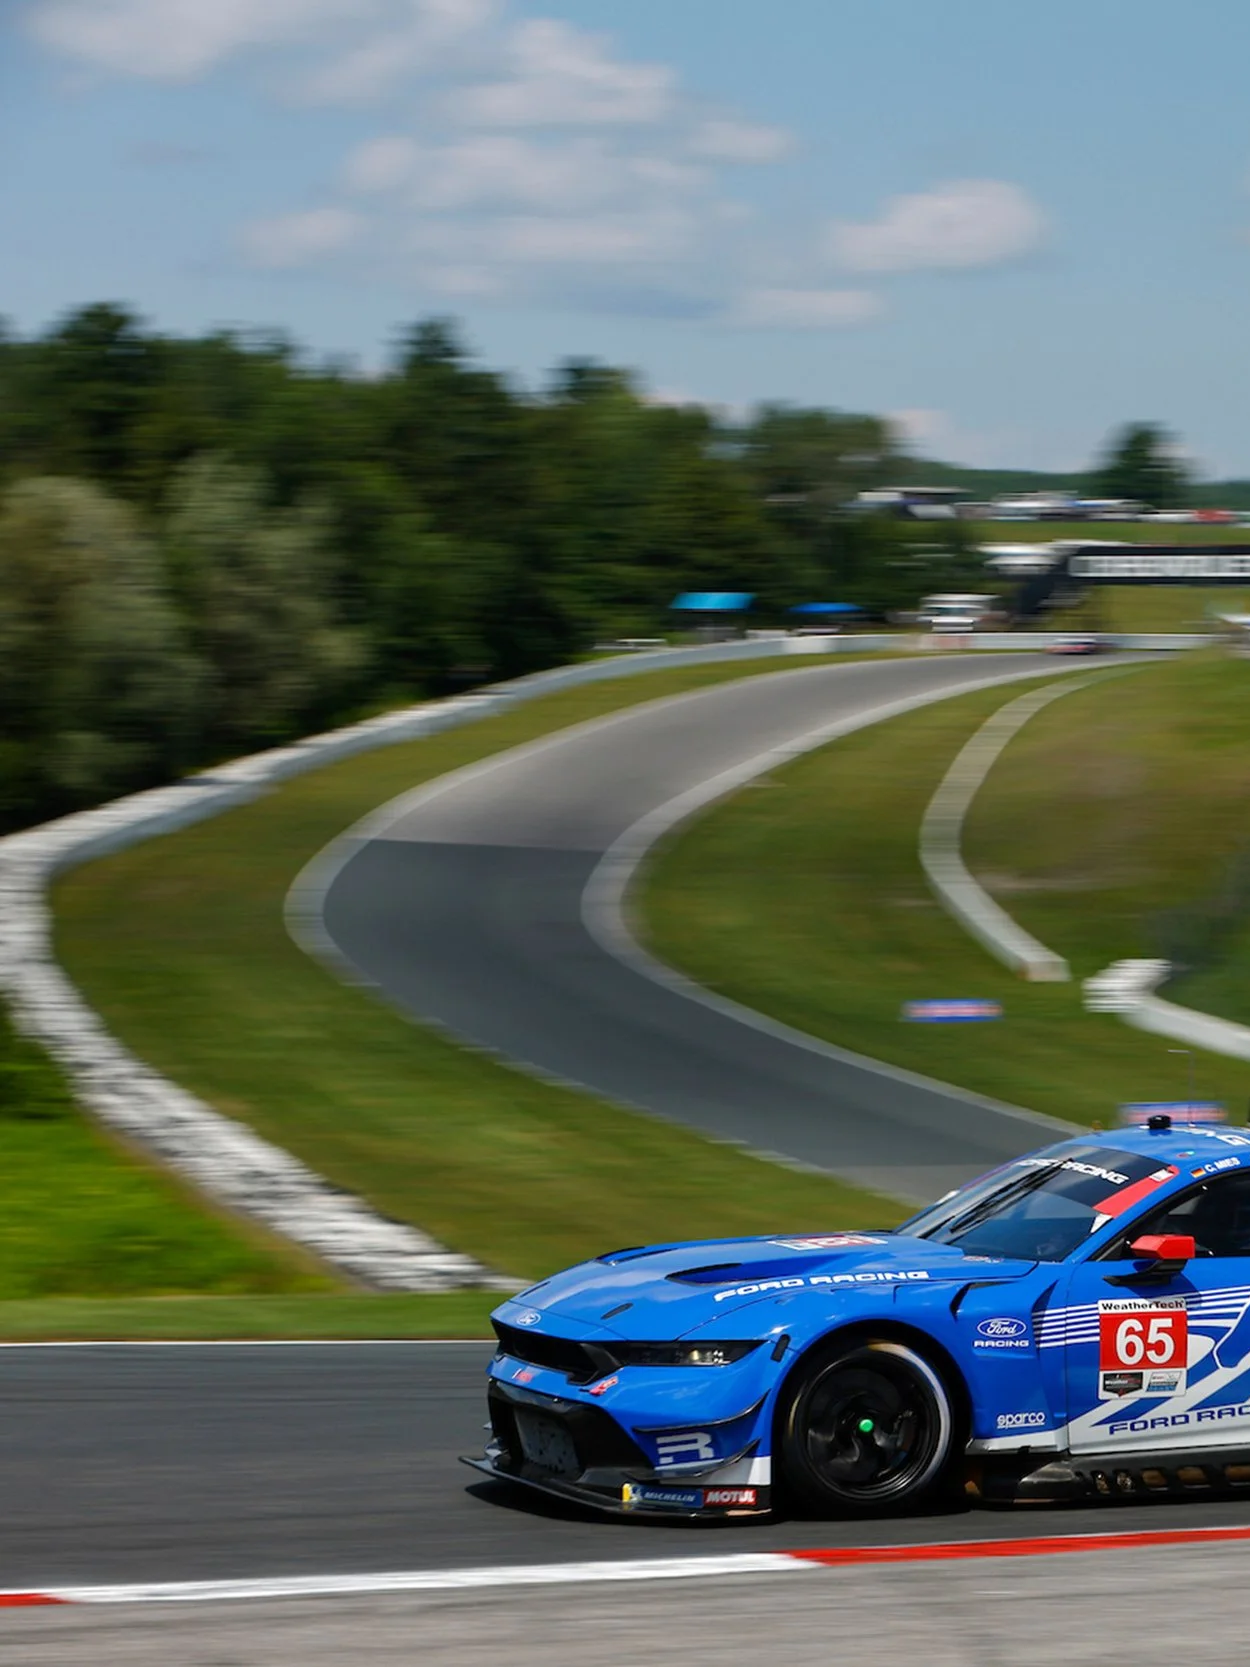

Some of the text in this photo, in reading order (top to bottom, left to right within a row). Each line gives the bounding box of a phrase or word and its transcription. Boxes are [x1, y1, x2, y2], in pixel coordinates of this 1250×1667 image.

[713, 1270, 930, 1302] FORD RACING
[1101, 1300, 1184, 1311] WeatherTech
[986, 1320, 1017, 1335] Ford
[973, 1339, 1029, 1348] RACING
[1116, 1317, 1174, 1366] 65
[996, 1411, 1045, 1429] sparco
[1108, 1413, 1190, 1435] FORD
[644, 1490, 697, 1503] MICHELIN
[705, 1489, 757, 1503] MOTUL
